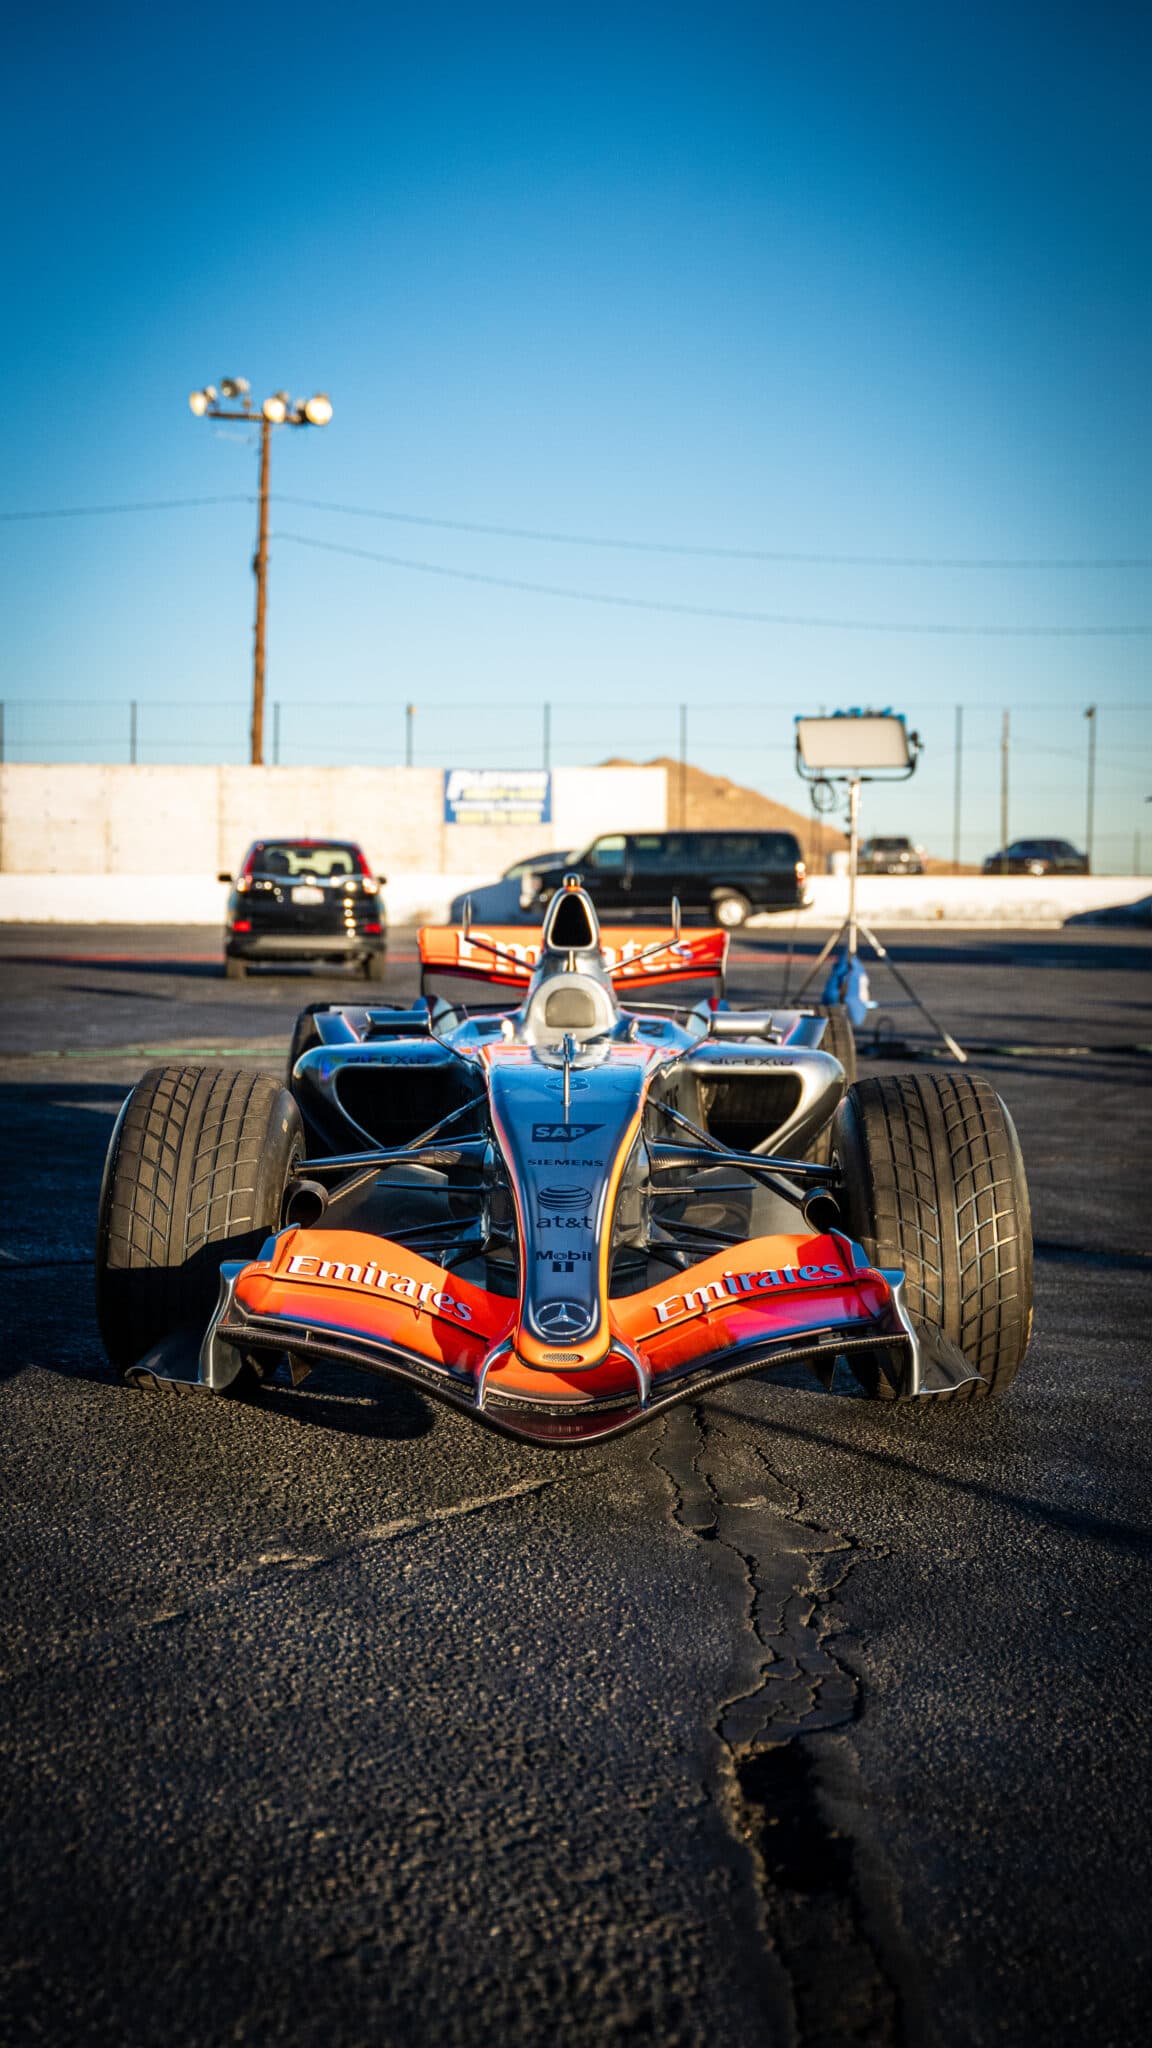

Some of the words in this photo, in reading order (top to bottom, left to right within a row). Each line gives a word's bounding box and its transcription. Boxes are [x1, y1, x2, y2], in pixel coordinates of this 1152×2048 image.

[535, 1126, 586, 1138] SAP
[527, 1159, 605, 1167] SIEMENS
[536, 1215, 593, 1229] at&t
[535, 1250, 592, 1261] Mobil
[287, 1255, 473, 1321] Emirates
[653, 1263, 843, 1323] Emirates
